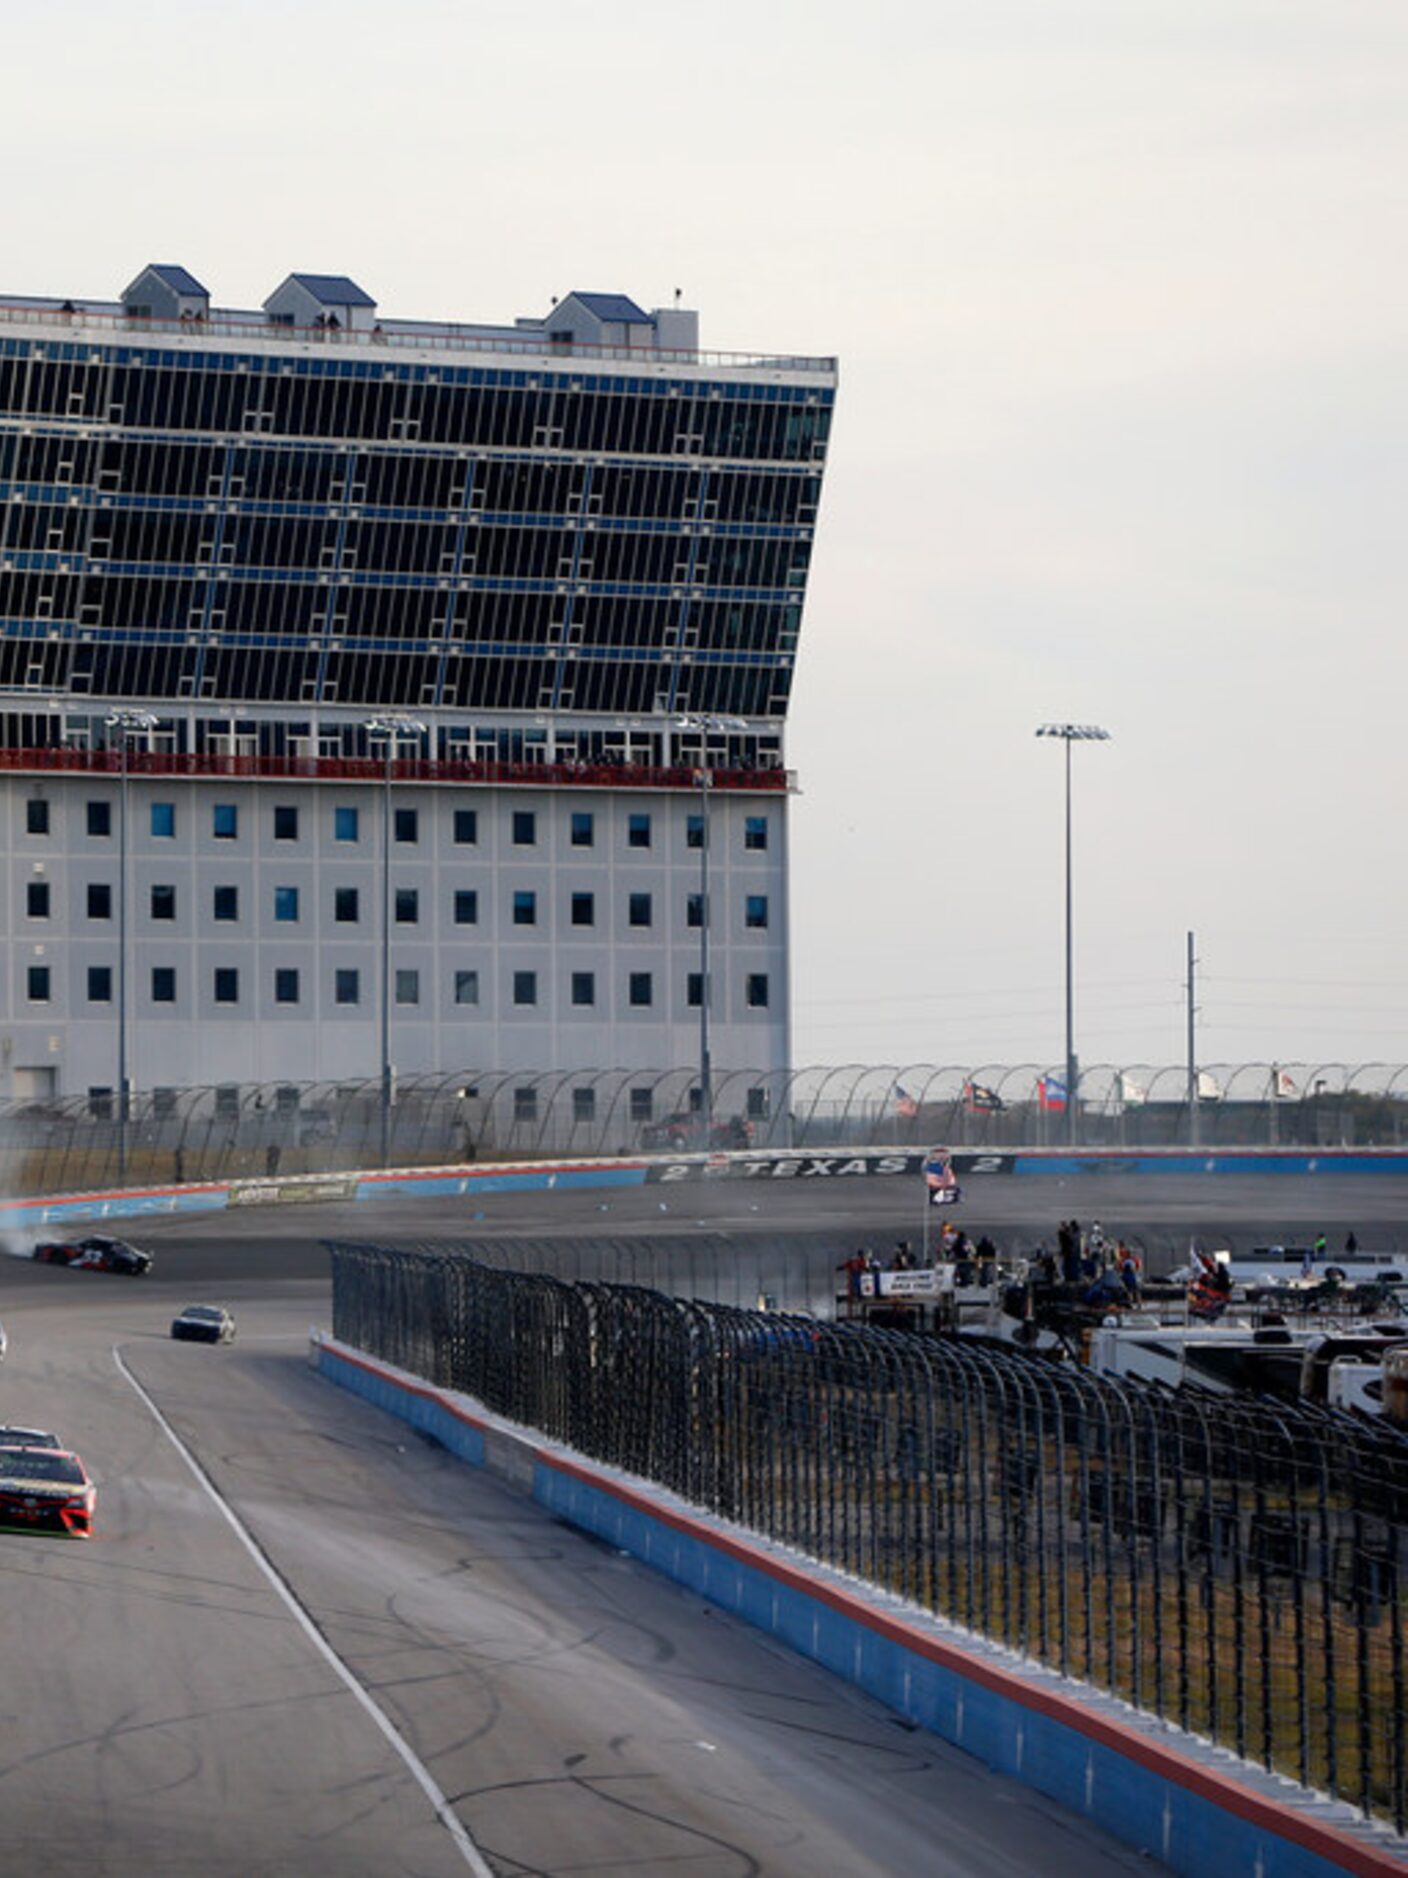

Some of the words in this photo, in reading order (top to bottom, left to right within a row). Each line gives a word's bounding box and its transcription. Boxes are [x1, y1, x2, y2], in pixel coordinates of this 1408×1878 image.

[660, 1164, 689, 1181] 2
[745, 1157, 907, 1177] TEXAS
[970, 1156, 1003, 1173] 2
